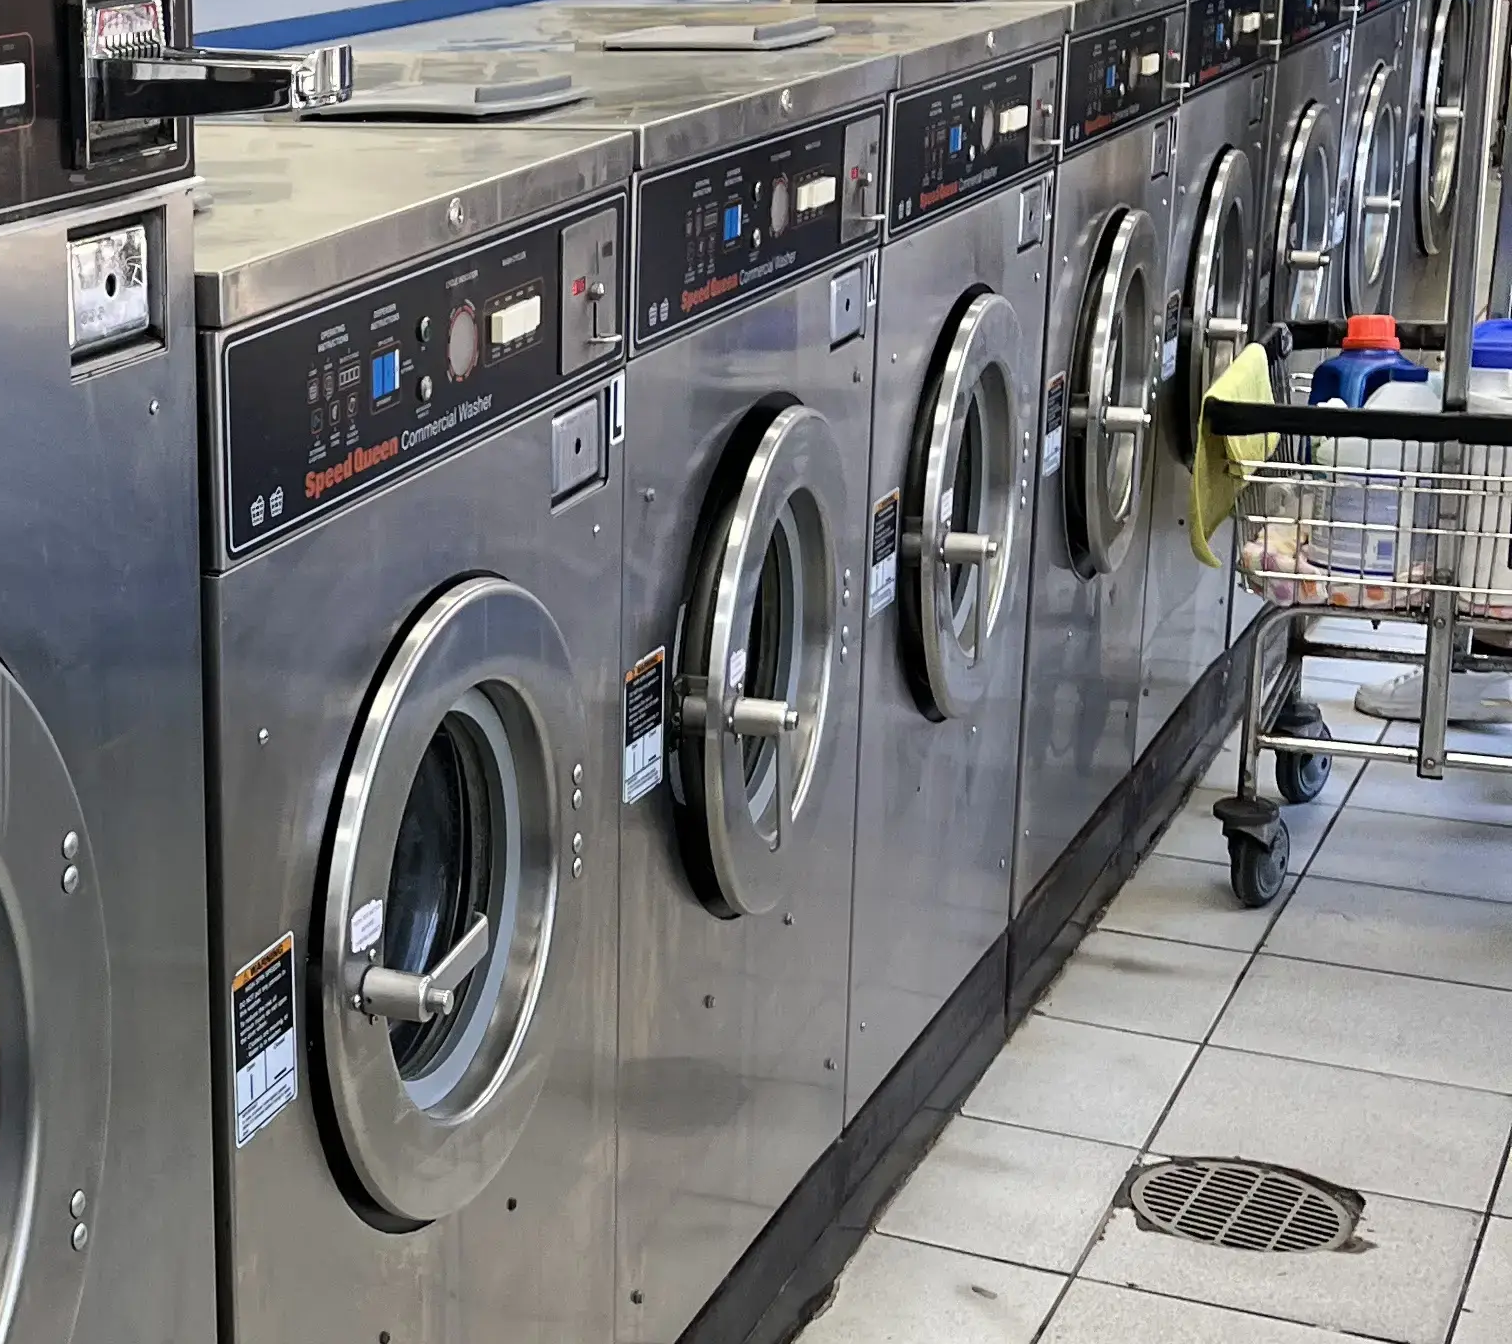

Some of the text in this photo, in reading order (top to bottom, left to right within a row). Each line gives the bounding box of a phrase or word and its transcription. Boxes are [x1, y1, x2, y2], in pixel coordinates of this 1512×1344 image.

[305, 452, 352, 499] Speed
[354, 436, 398, 471] Queen
[401, 410, 457, 451] Commercial
[458, 394, 492, 422] Washer
